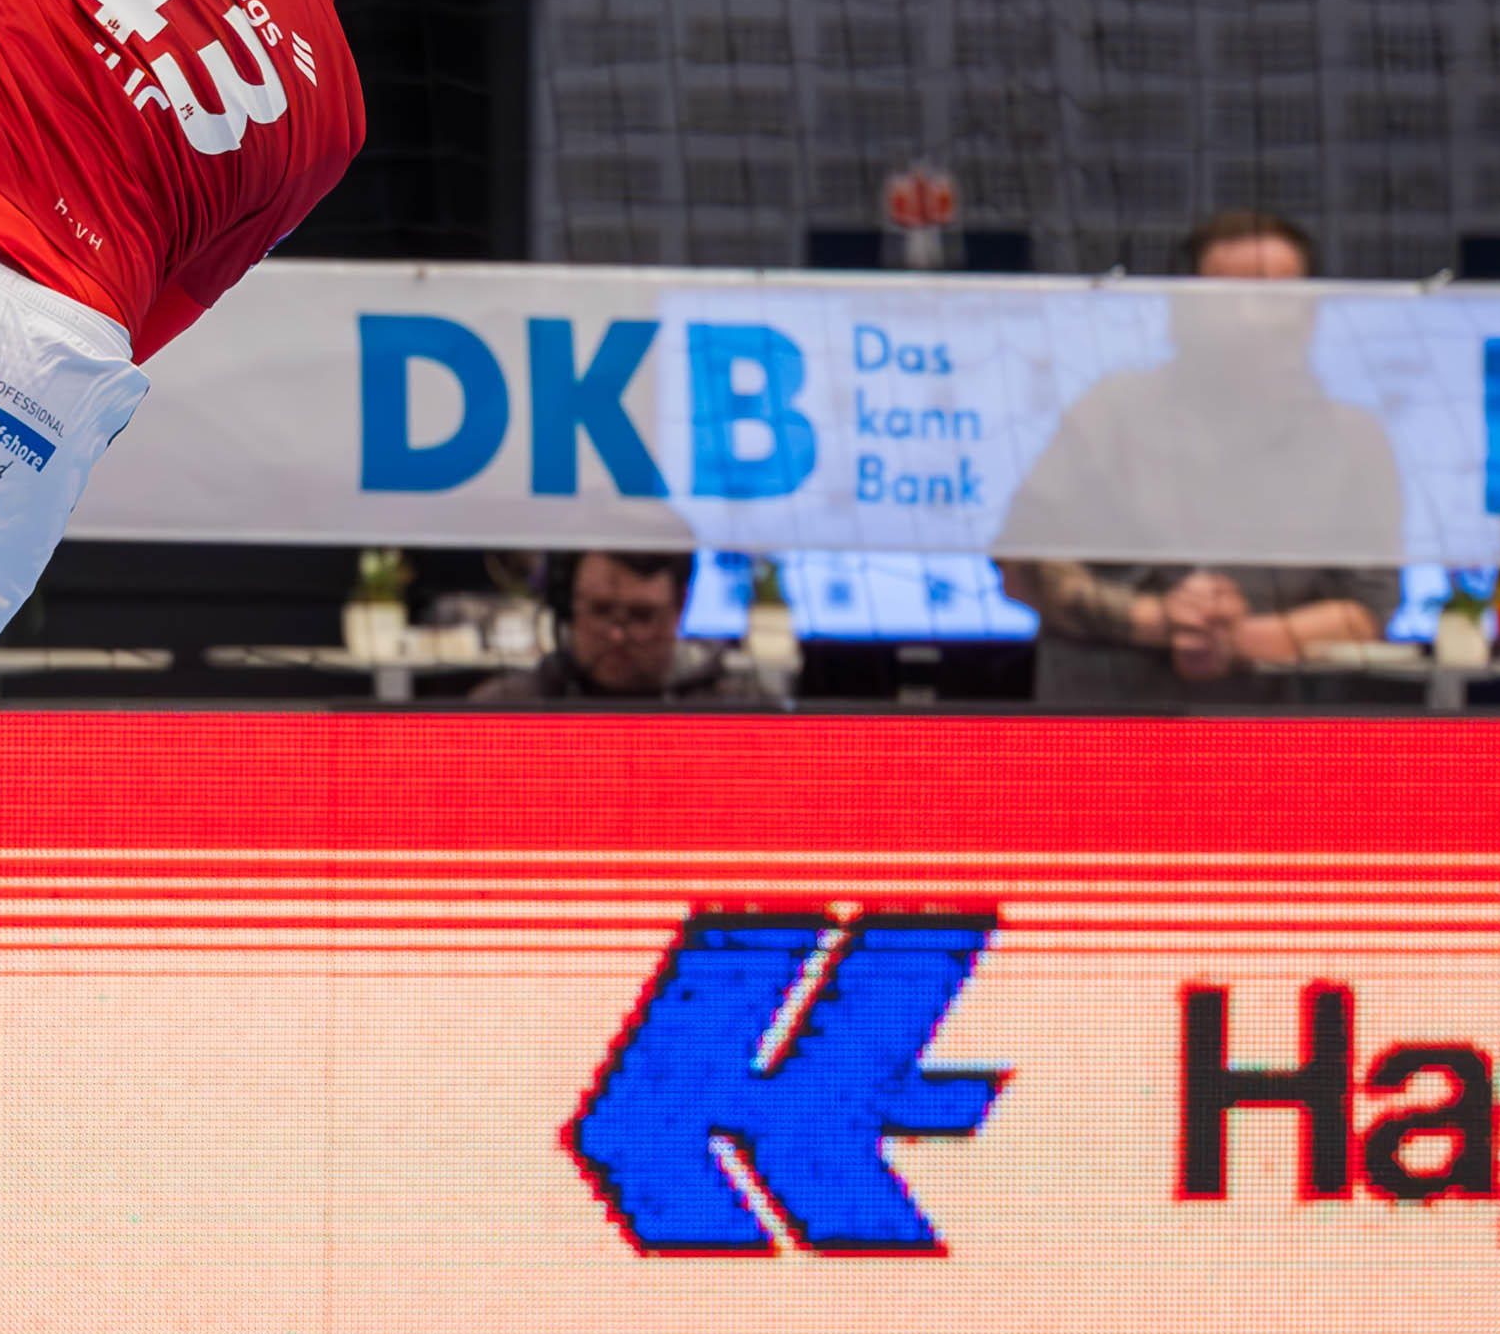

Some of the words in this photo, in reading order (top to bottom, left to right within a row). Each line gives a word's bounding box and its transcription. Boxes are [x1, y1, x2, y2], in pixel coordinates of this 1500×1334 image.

[854, 322, 952, 376] Das
[357, 313, 818, 500] DKB
[856, 391, 982, 442] kann
[855, 455, 984, 508] Bank
